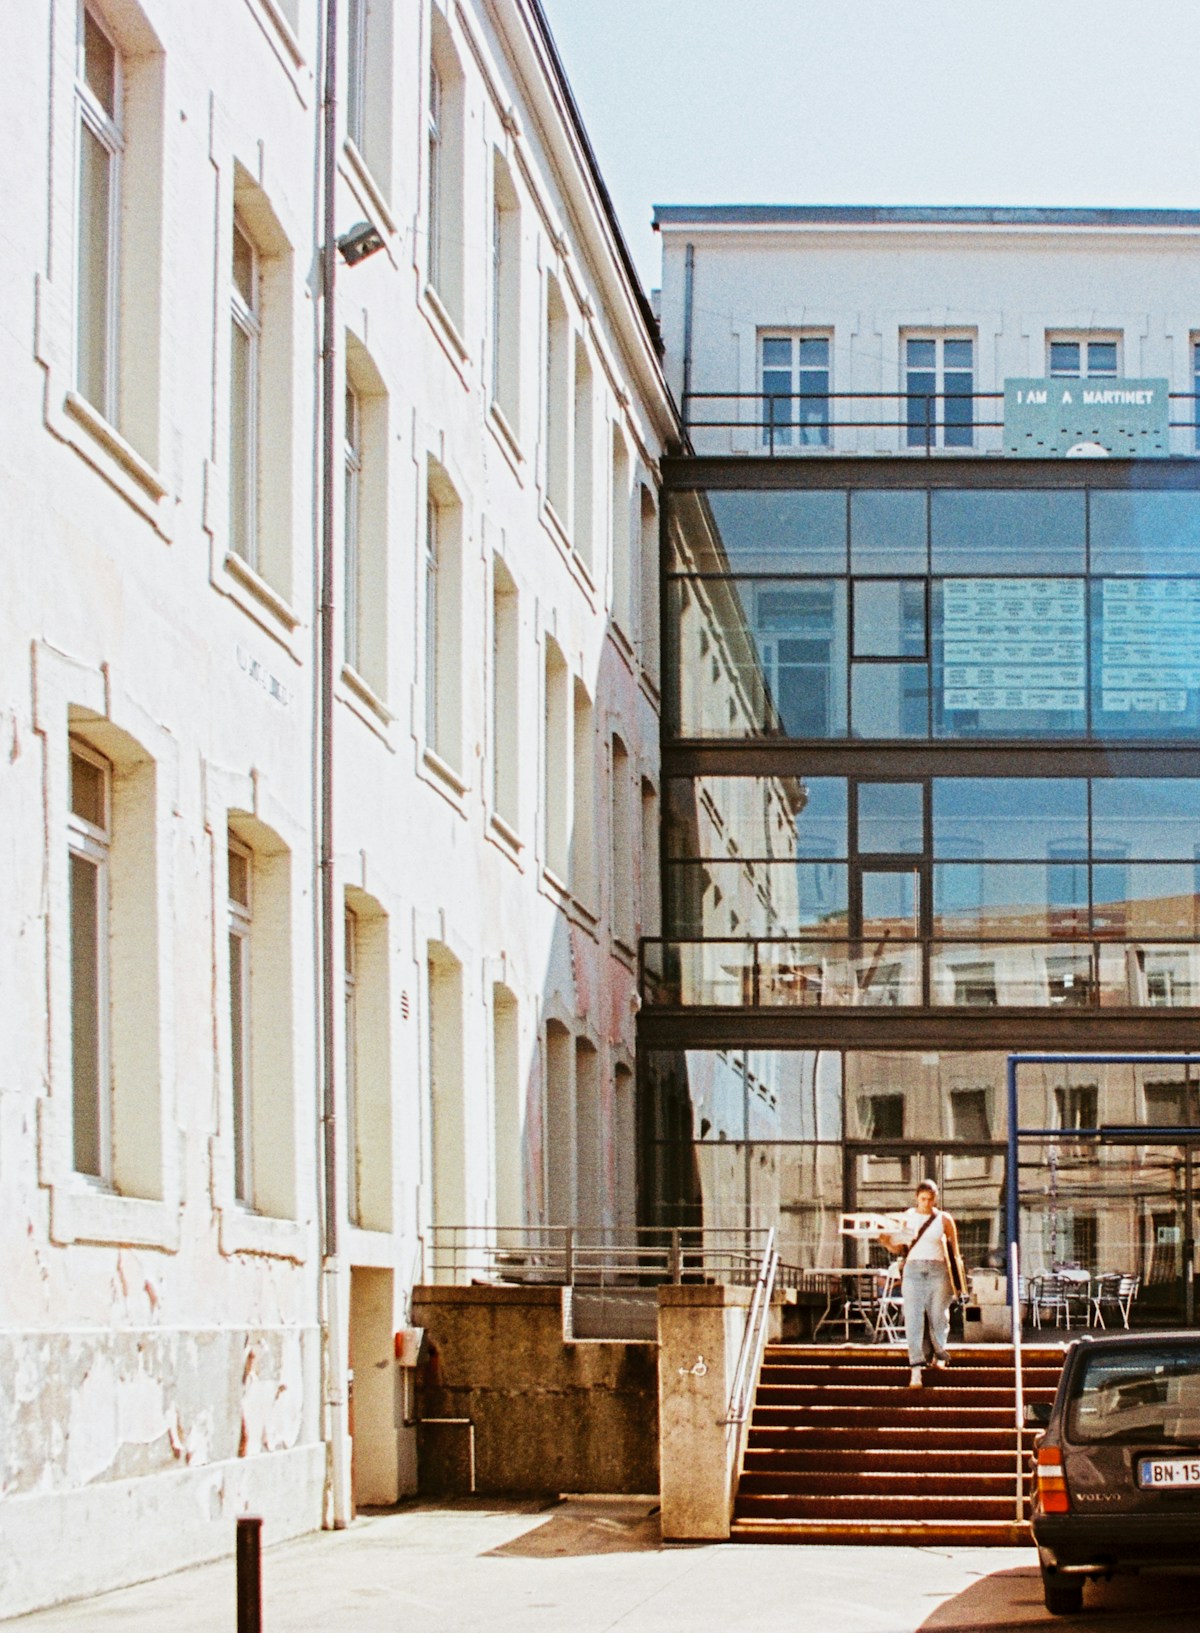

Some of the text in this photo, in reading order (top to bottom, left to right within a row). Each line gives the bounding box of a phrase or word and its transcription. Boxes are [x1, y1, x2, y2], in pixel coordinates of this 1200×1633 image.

[1017, 390, 1154, 405] I AM A MARTINET
[1076, 1493, 1121, 1501] VOLVO
